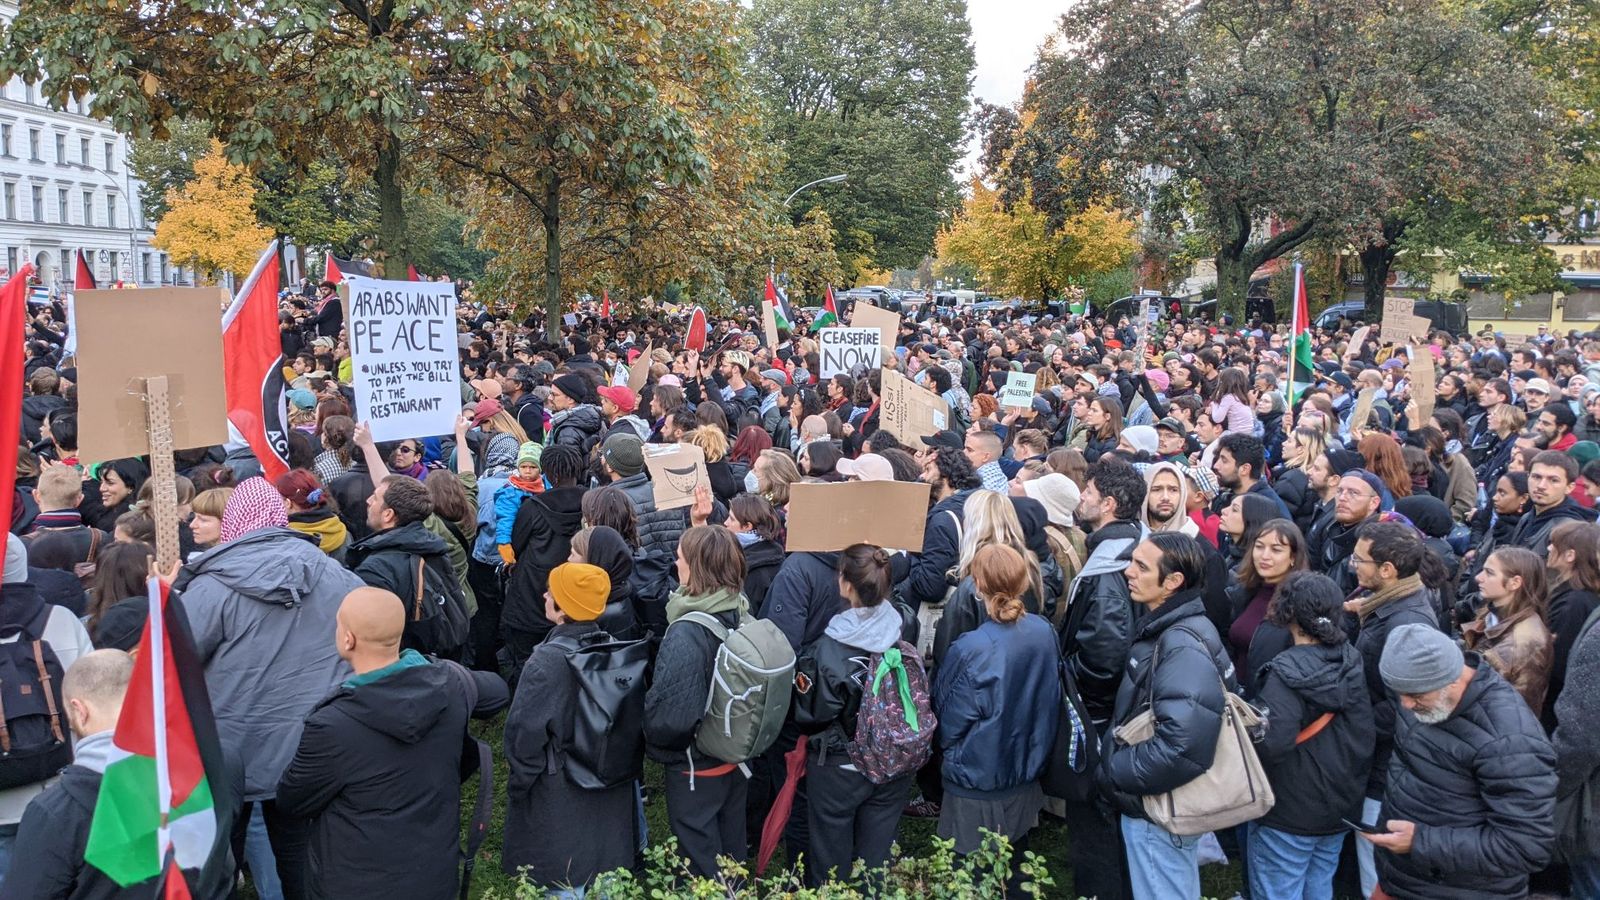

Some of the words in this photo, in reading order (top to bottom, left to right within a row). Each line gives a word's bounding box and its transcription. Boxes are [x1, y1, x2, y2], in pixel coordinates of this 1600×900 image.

[352, 291, 404, 317] ARABS
[406, 292, 452, 317] WANT
[1387, 300, 1413, 312] STOP
[411, 361, 431, 372] YOU
[434, 360, 453, 371] TRY
[824, 347, 877, 371] NOW
[368, 377, 382, 388] TO
[386, 375, 401, 387] PAY
[406, 372, 424, 381] THE
[428, 371, 452, 382] BILL
[370, 390, 383, 403] AT
[389, 388, 405, 400] THE
[1007, 388, 1032, 397] PALESTINE
[371, 398, 442, 419] RESTAURANT
